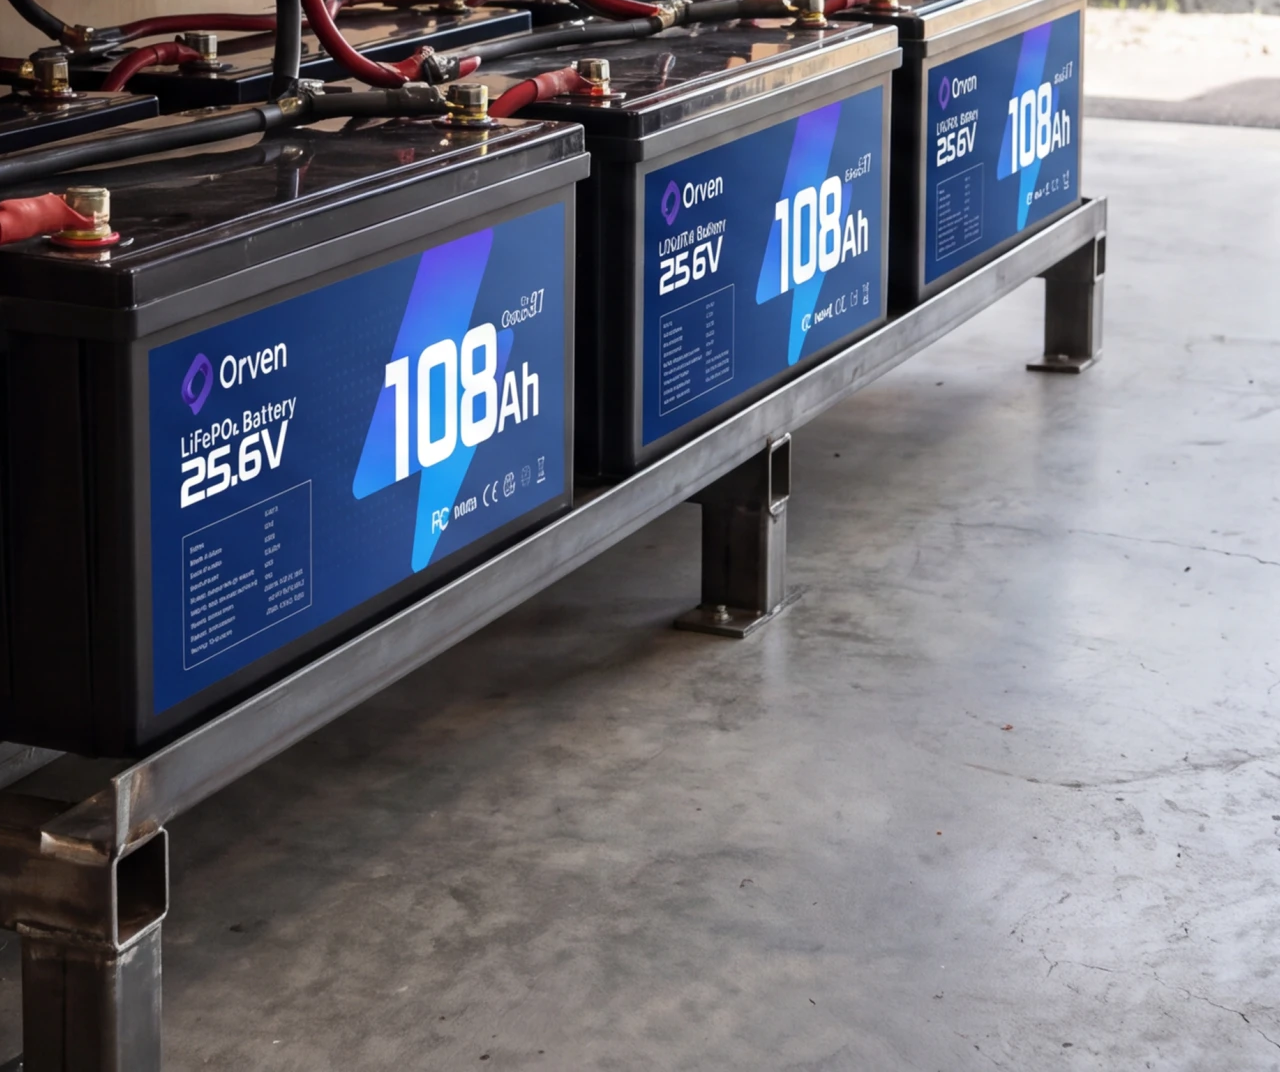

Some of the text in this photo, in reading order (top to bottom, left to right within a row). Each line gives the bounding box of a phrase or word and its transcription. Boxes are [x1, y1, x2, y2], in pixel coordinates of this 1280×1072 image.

[1008, 81, 1071, 174] 108Ah
[682, 176, 724, 209] Orven
[775, 175, 869, 294] 108Ah
[220, 342, 288, 389] Orven
[384, 321, 539, 482] 108Ah
[242, 396, 297, 433] Battery
[180, 419, 289, 509] 25.6V
